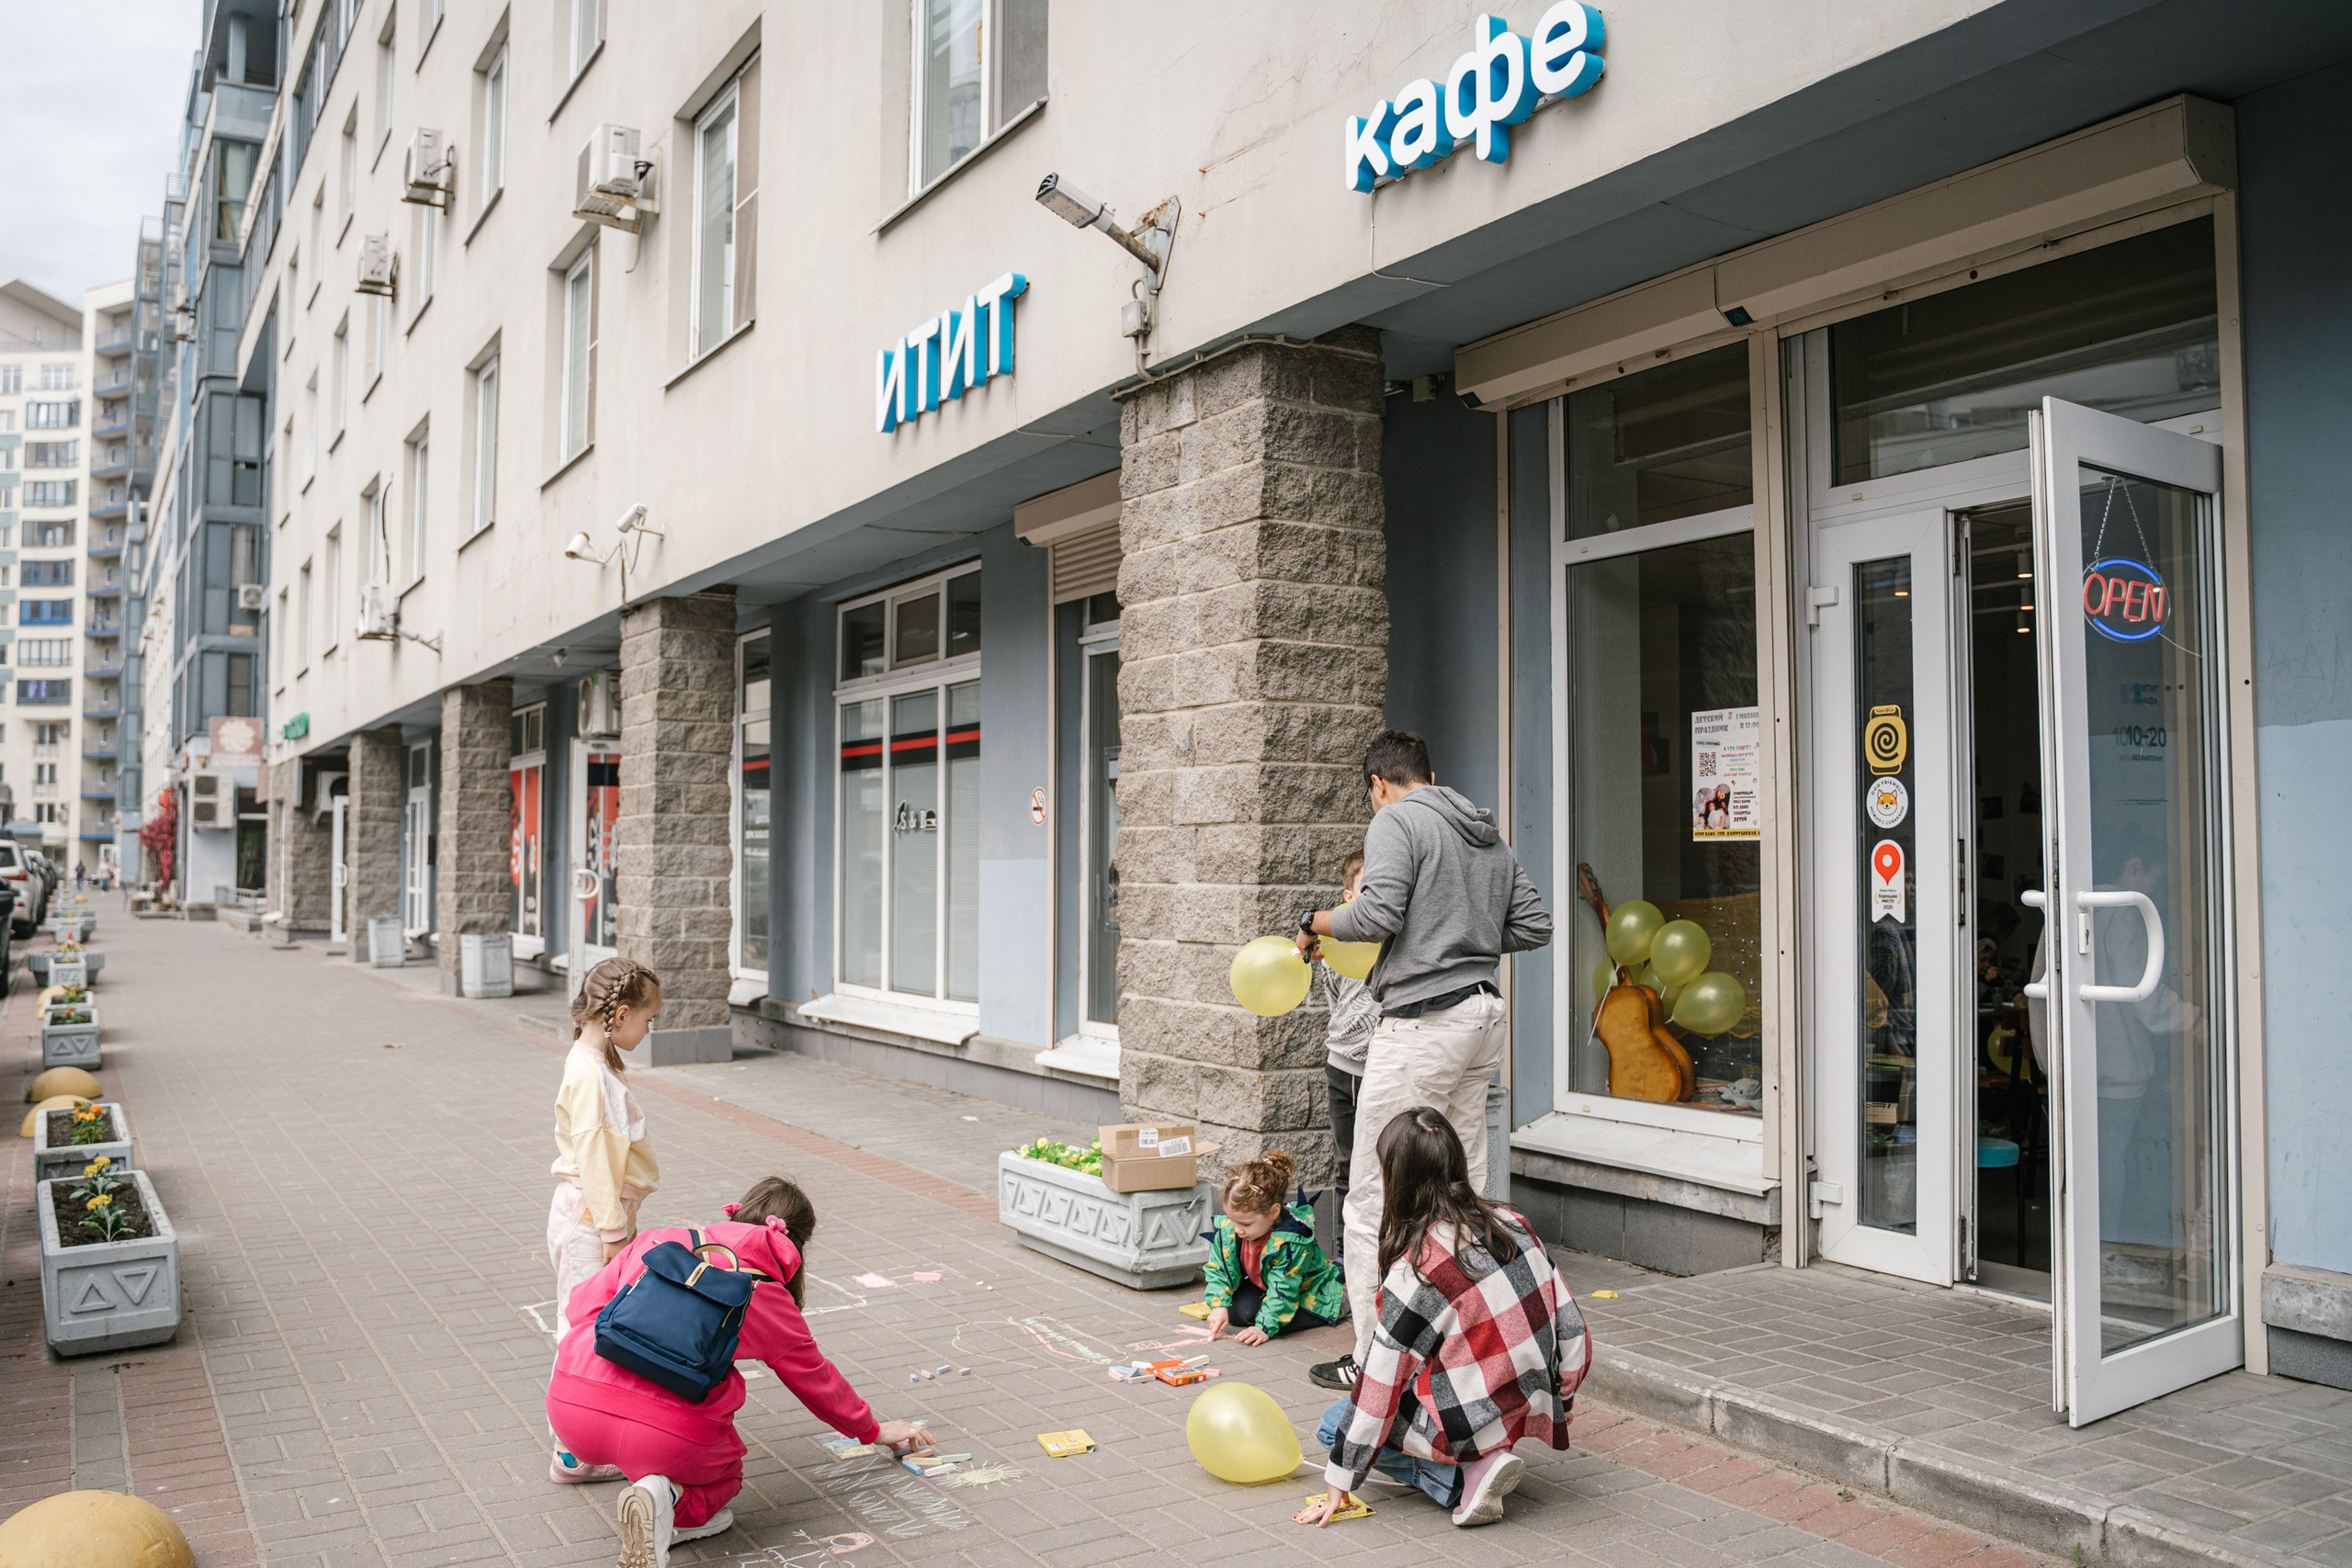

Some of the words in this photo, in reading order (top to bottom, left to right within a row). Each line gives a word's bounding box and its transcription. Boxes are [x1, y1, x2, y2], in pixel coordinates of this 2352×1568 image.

[1346, 0, 1600, 193] кафе
[876, 272, 1021, 433] ИТИТ
[2084, 573, 2165, 622] OPEN
[1695, 712, 1724, 724] ДЕТСКИЙ
[1695, 725, 1728, 734] ПРАЗДНИК
[2126, 725, 2166, 748] 10-20
[1871, 783, 1881, 795] DOG
[1881, 780, 1904, 795] FRIENDLY
